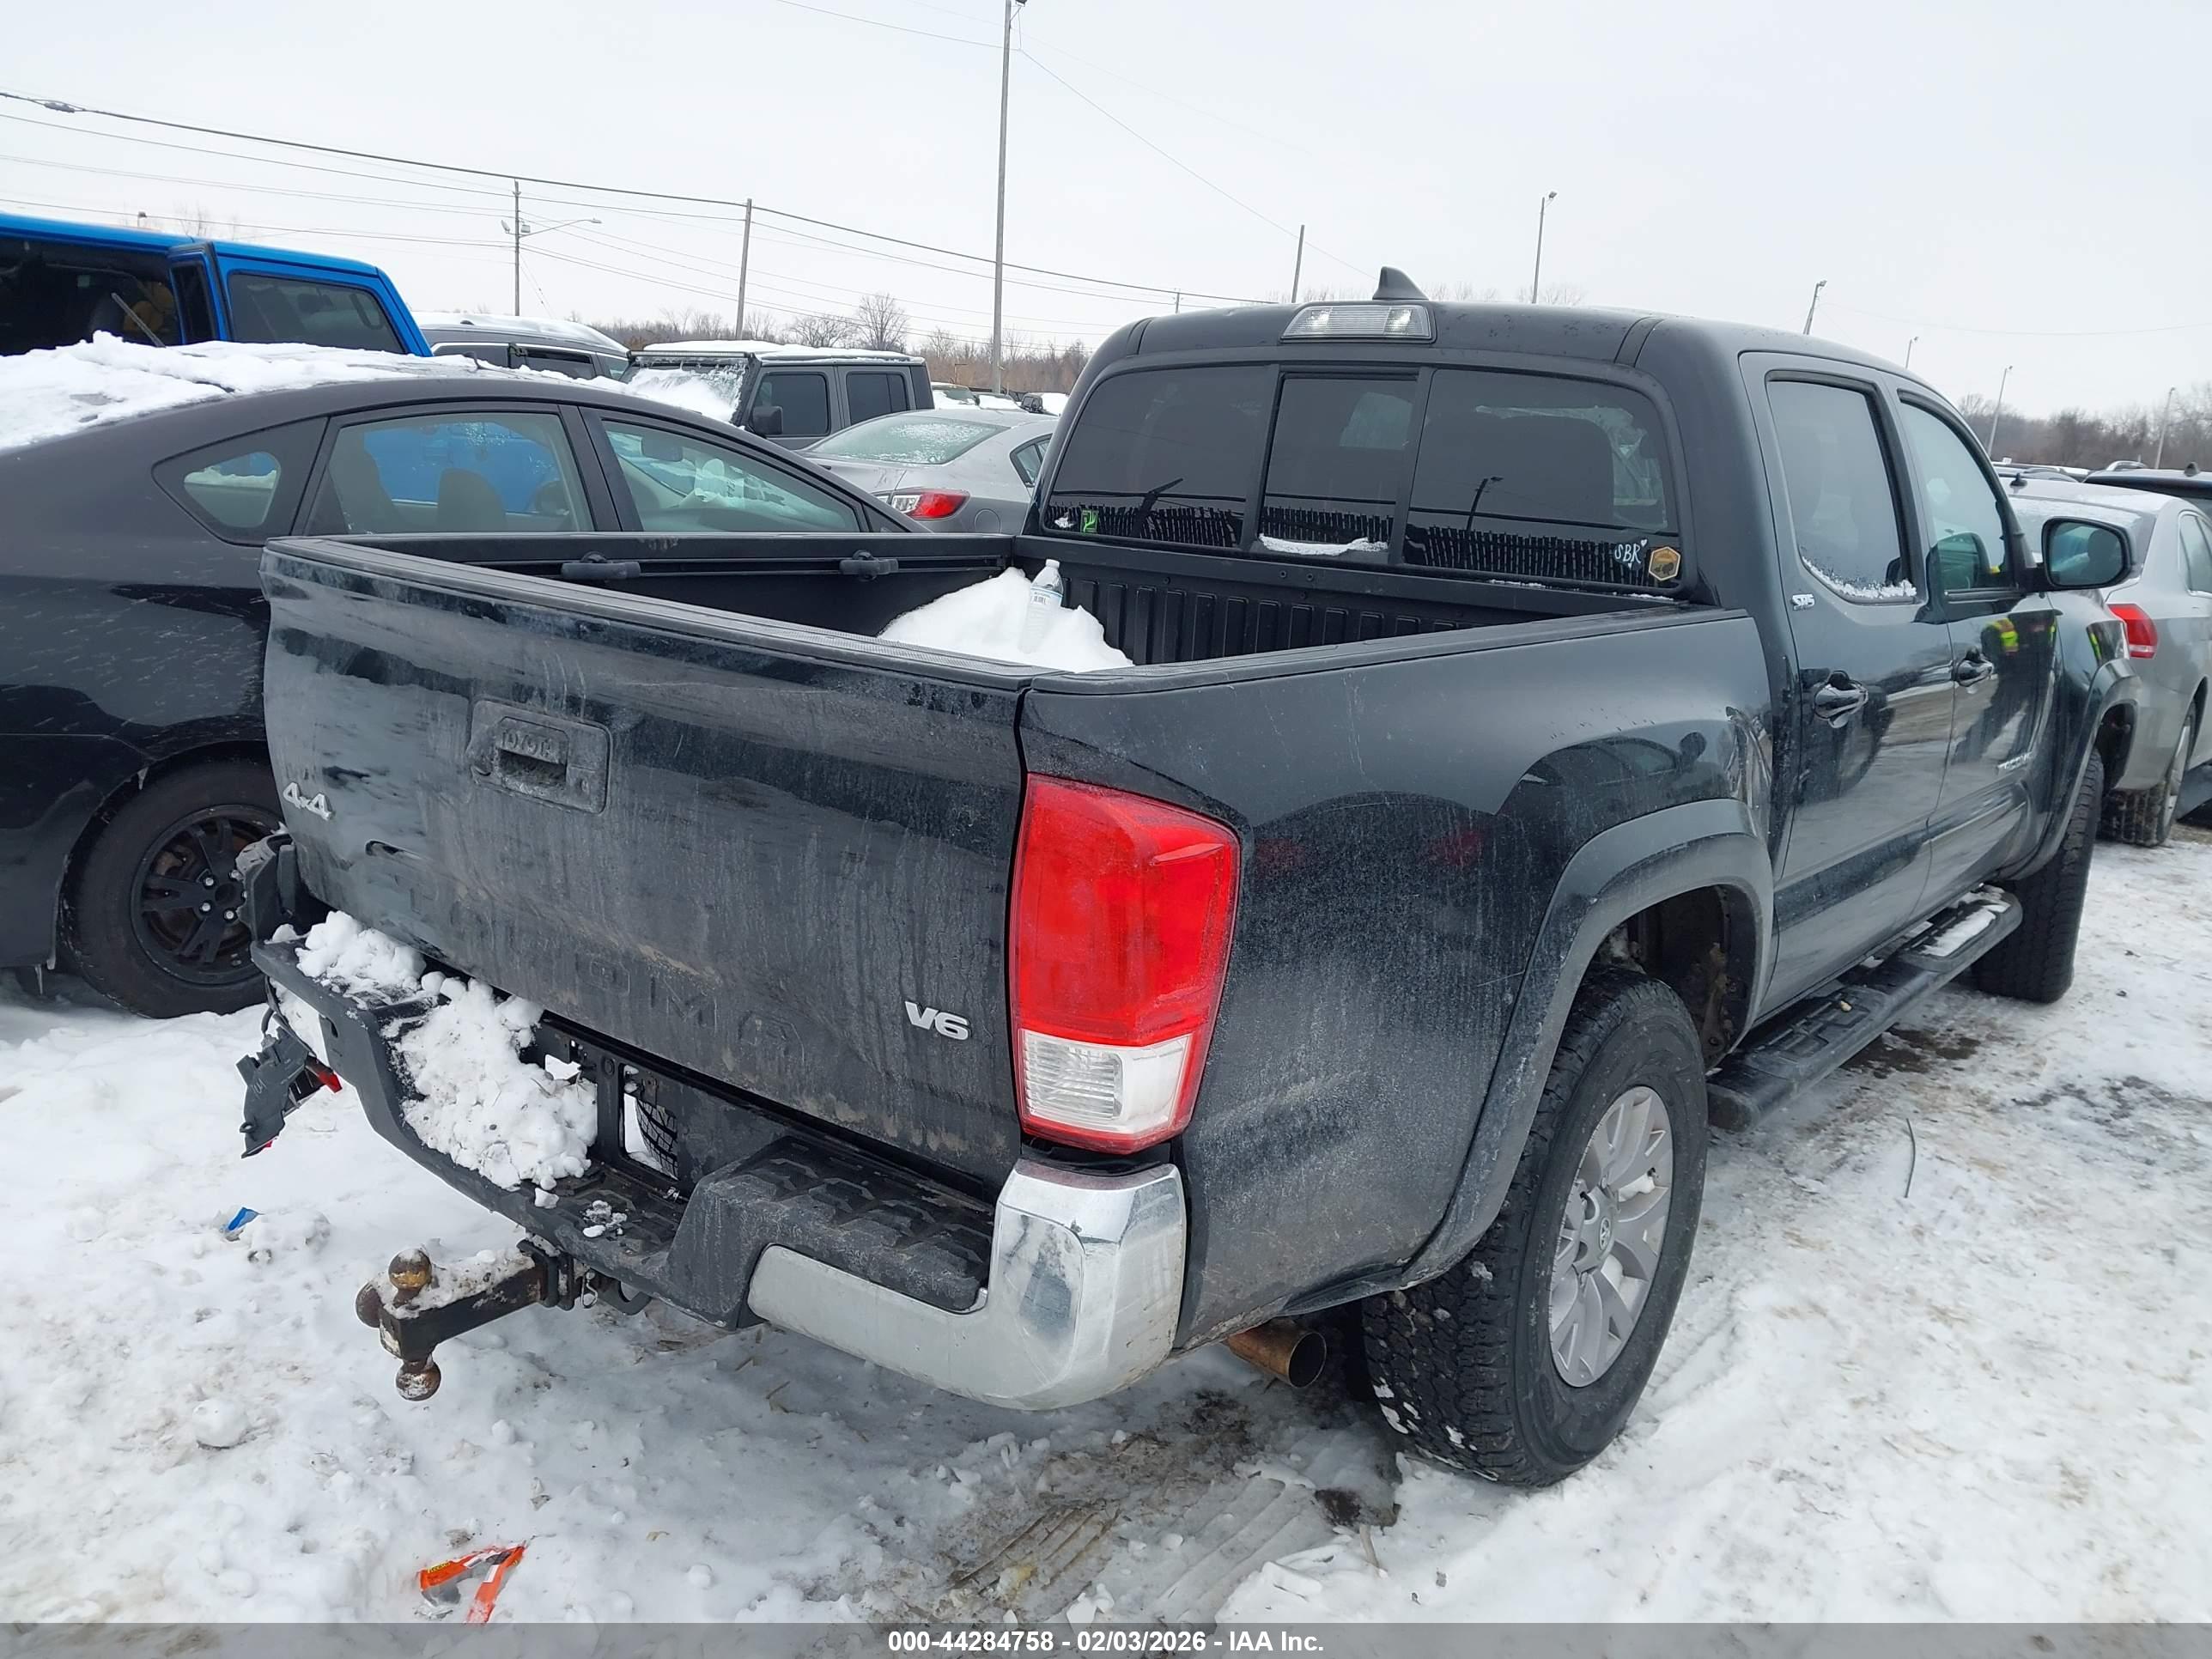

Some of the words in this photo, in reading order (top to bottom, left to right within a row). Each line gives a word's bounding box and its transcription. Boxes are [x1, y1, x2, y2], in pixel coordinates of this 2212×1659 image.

[1614, 544, 1642, 564] SBR
[1792, 593, 1815, 610] SR5
[904, 1000, 969, 1040] V6
